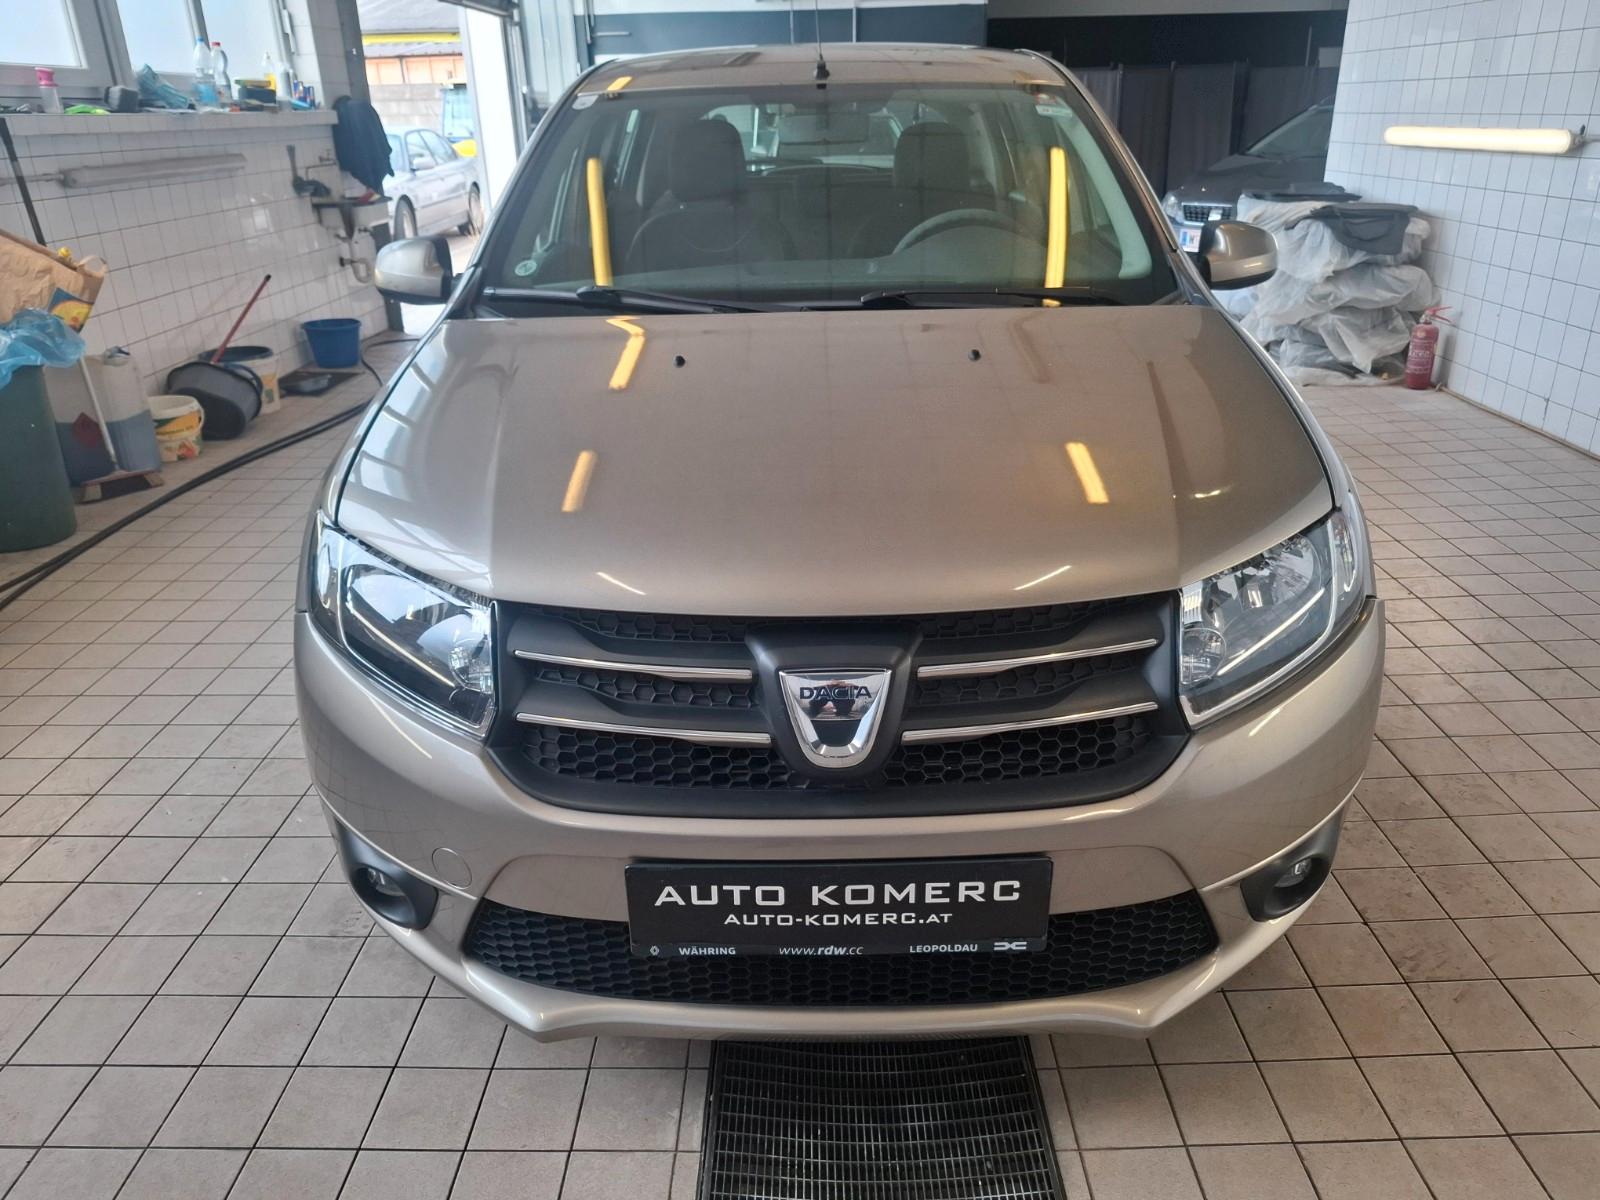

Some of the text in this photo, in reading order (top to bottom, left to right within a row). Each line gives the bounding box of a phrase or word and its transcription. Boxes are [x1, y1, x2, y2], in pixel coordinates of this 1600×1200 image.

[799, 686, 872, 700] DACIA
[654, 880, 1021, 906] AUTO KOMERC
[724, 912, 953, 926] AUTO-KOMERC.AT
[678, 946, 737, 956] WÄHRING
[779, 945, 864, 956] www.rdw.cc
[909, 944, 978, 953] LEOPOLDAU
